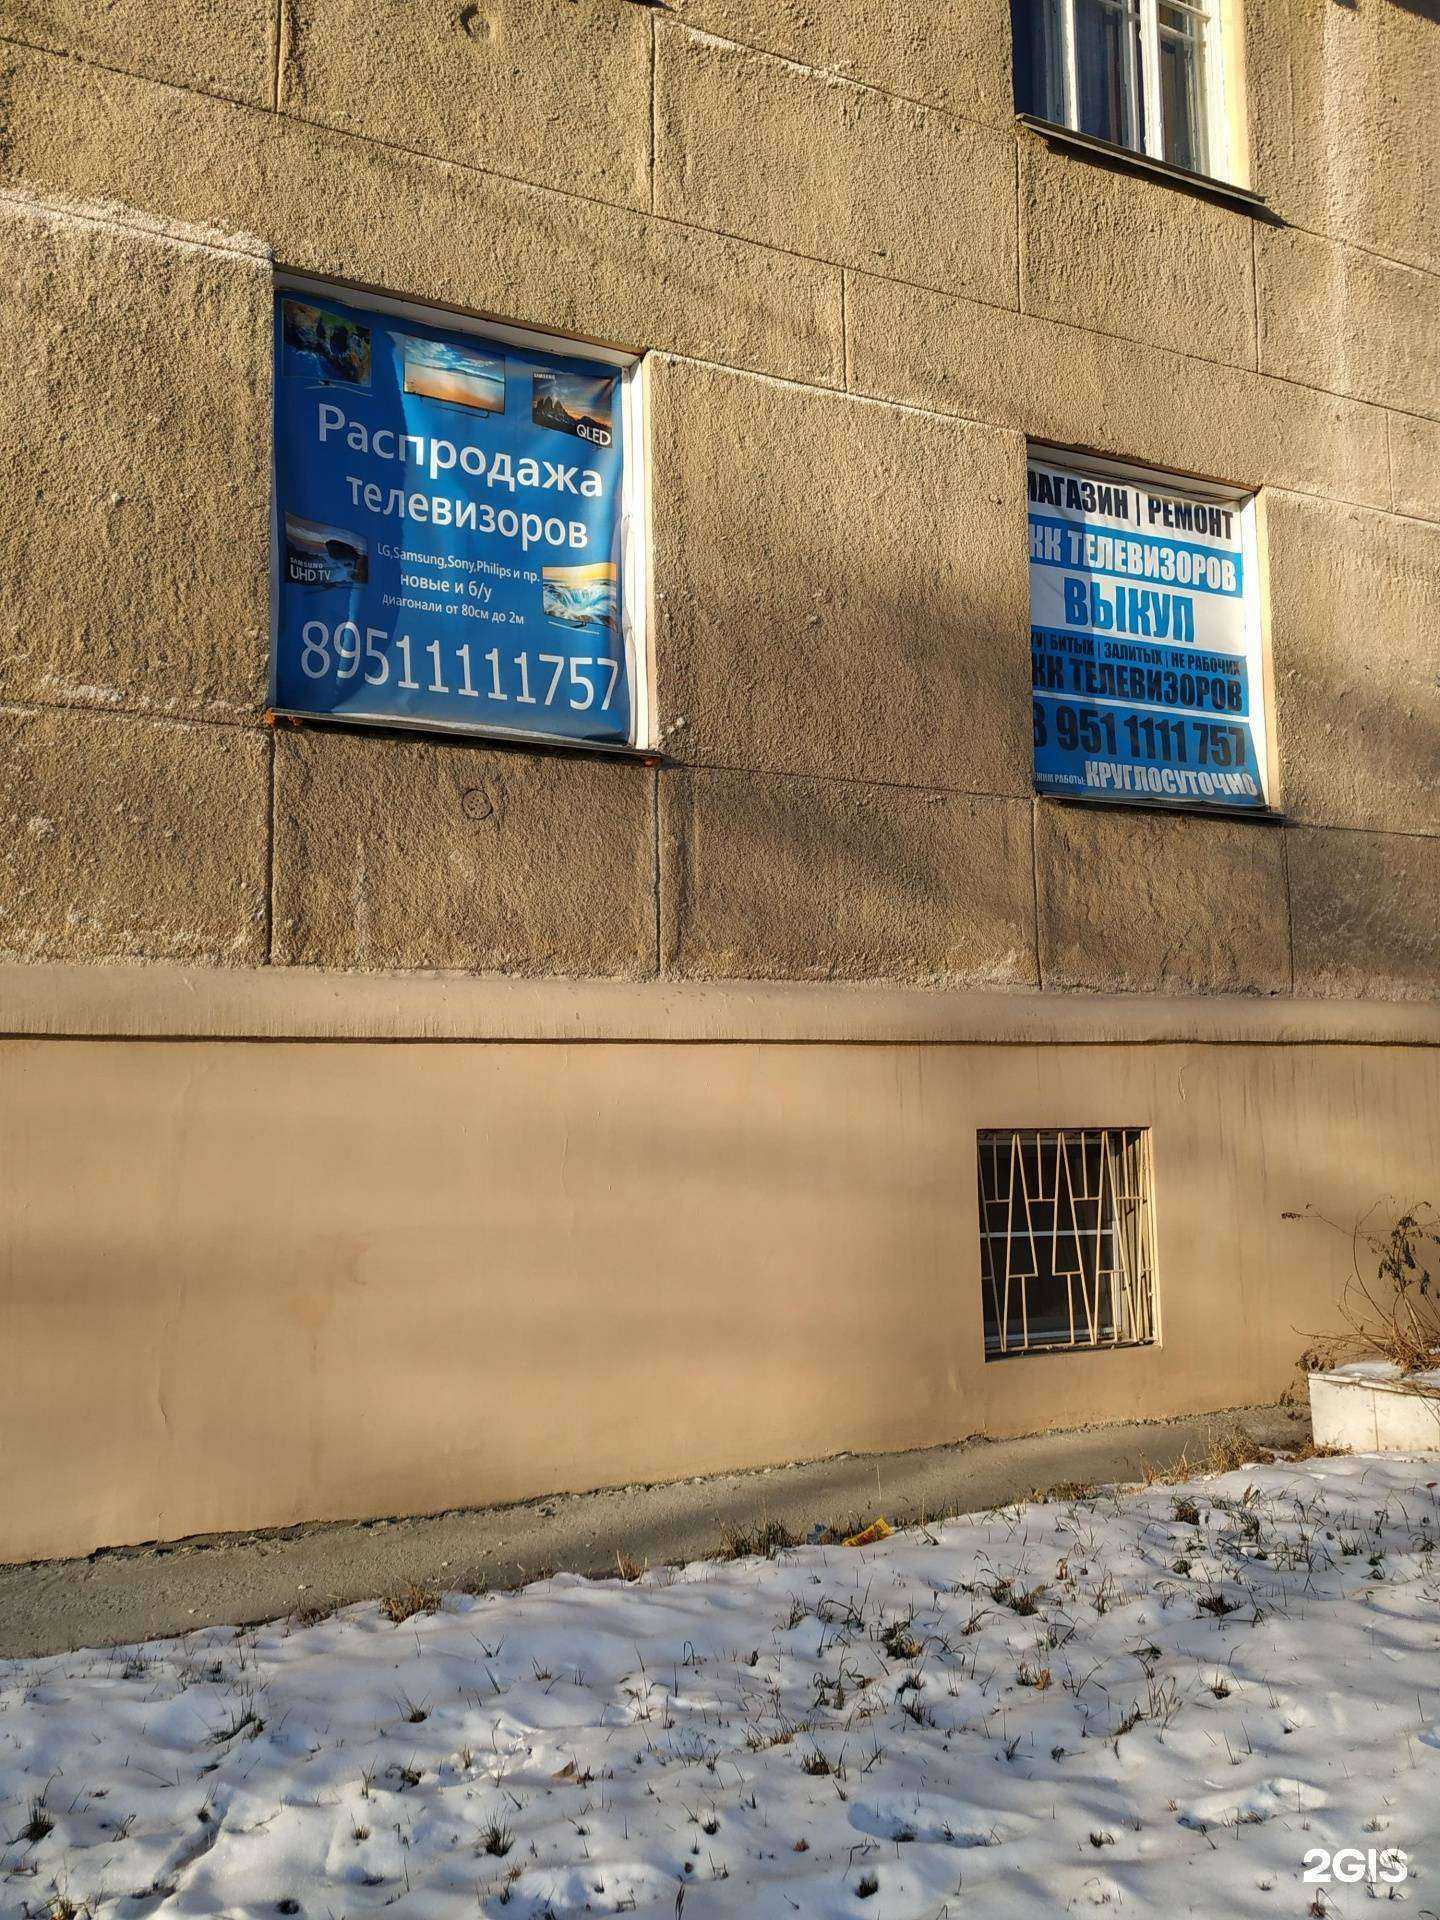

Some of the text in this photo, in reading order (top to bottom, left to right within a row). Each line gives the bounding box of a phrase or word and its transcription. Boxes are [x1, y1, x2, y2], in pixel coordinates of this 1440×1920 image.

[318, 402, 603, 498] Распродажа
[576, 424, 612, 446] QLED
[345, 473, 589, 552] телевизоров
[1148, 495, 1234, 540] РЕМОНТ
[290, 564, 332, 582] UHD TV
[513, 569, 520, 578] и
[523, 571, 541, 584] пр.
[1067, 529, 1237, 592] ТЕЛЕВИЗОРОВ
[400, 573, 492, 603] новые и б/у
[1063, 577, 1195, 642] ВЫКУП
[445, 604, 459, 615] от
[461, 603, 489, 620] 80см
[491, 611, 506, 624] до
[508, 611, 524, 625] 2м
[300, 620, 618, 711] 89511111757
[1171, 652, 1185, 669] НЕ
[1069, 657, 1243, 712] ТЕЛЕВИЗОРОВ
[1056, 704, 1117, 756] 951
[1124, 713, 1187, 763] 1111
[1193, 722, 1245, 767] 757
[1085, 760, 1258, 796] КРУГЛОСУТОЧНО
